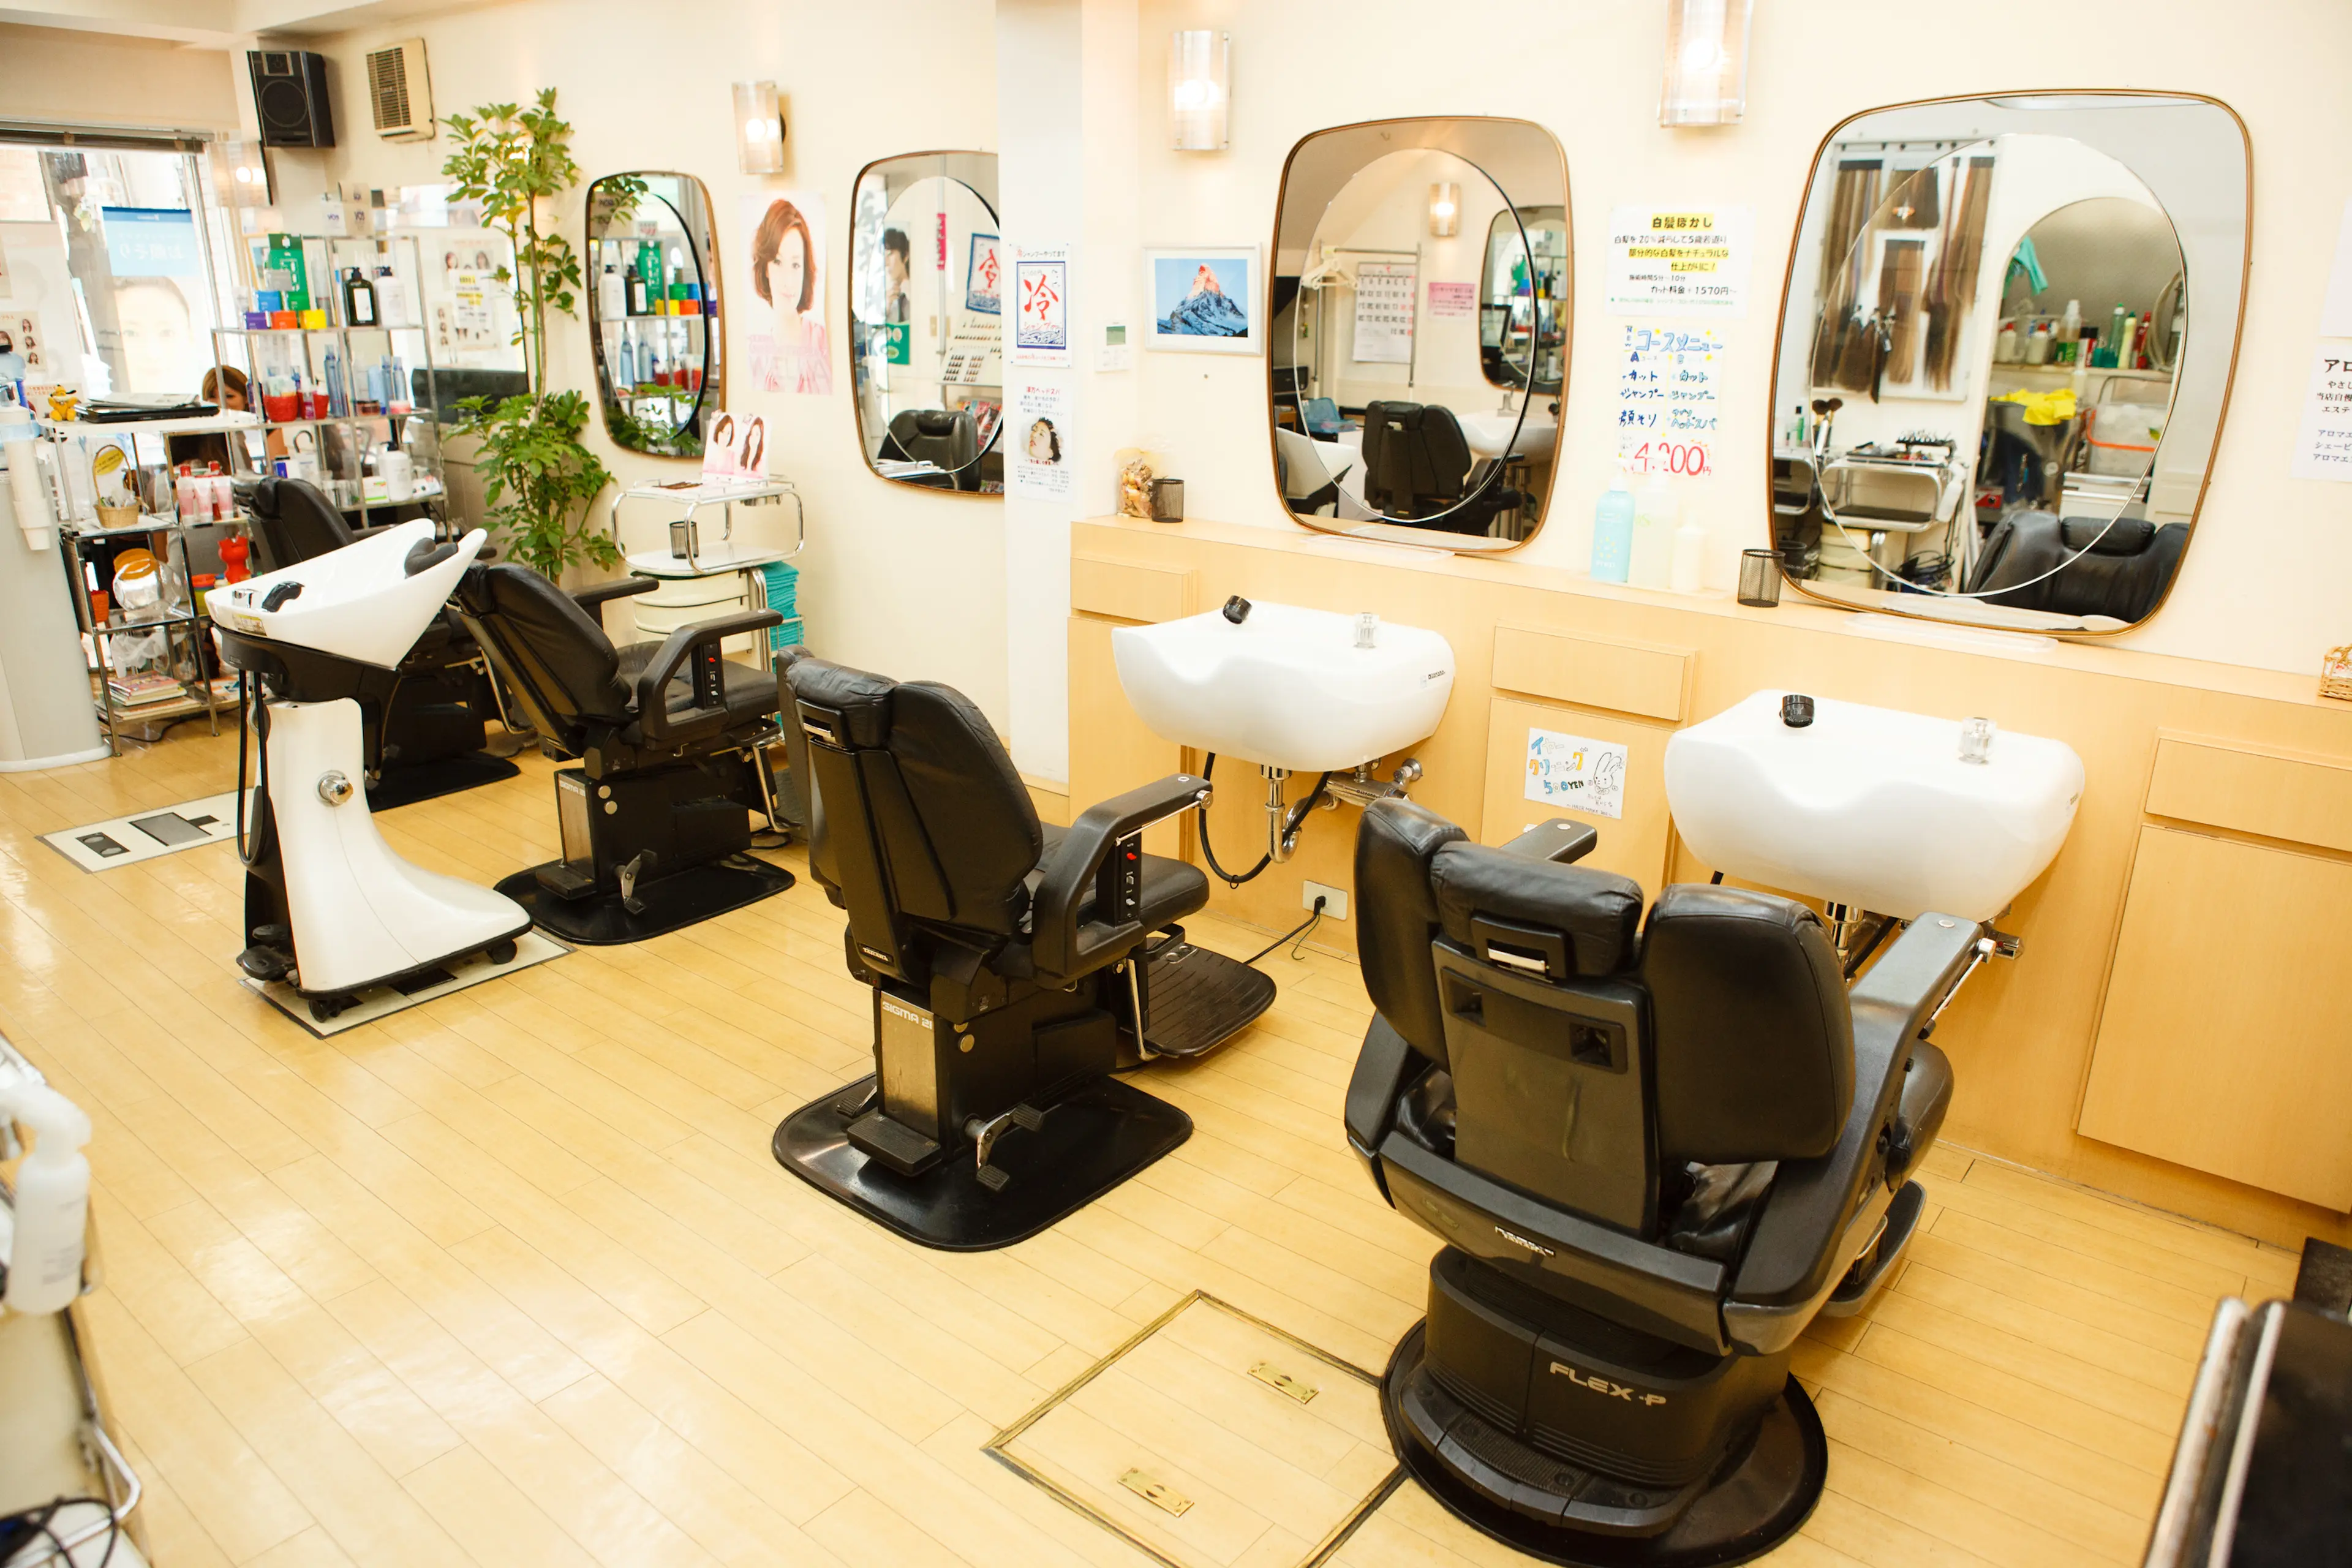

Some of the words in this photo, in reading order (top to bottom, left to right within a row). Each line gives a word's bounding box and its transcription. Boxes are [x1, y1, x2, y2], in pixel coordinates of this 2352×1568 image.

[1652, 216, 1713, 228] 白髪ぼかし
[1023, 274, 1059, 321] 冷
[1635, 330, 1723, 352] コースメニュー
[882, 1001, 919, 1024] SIGMA
